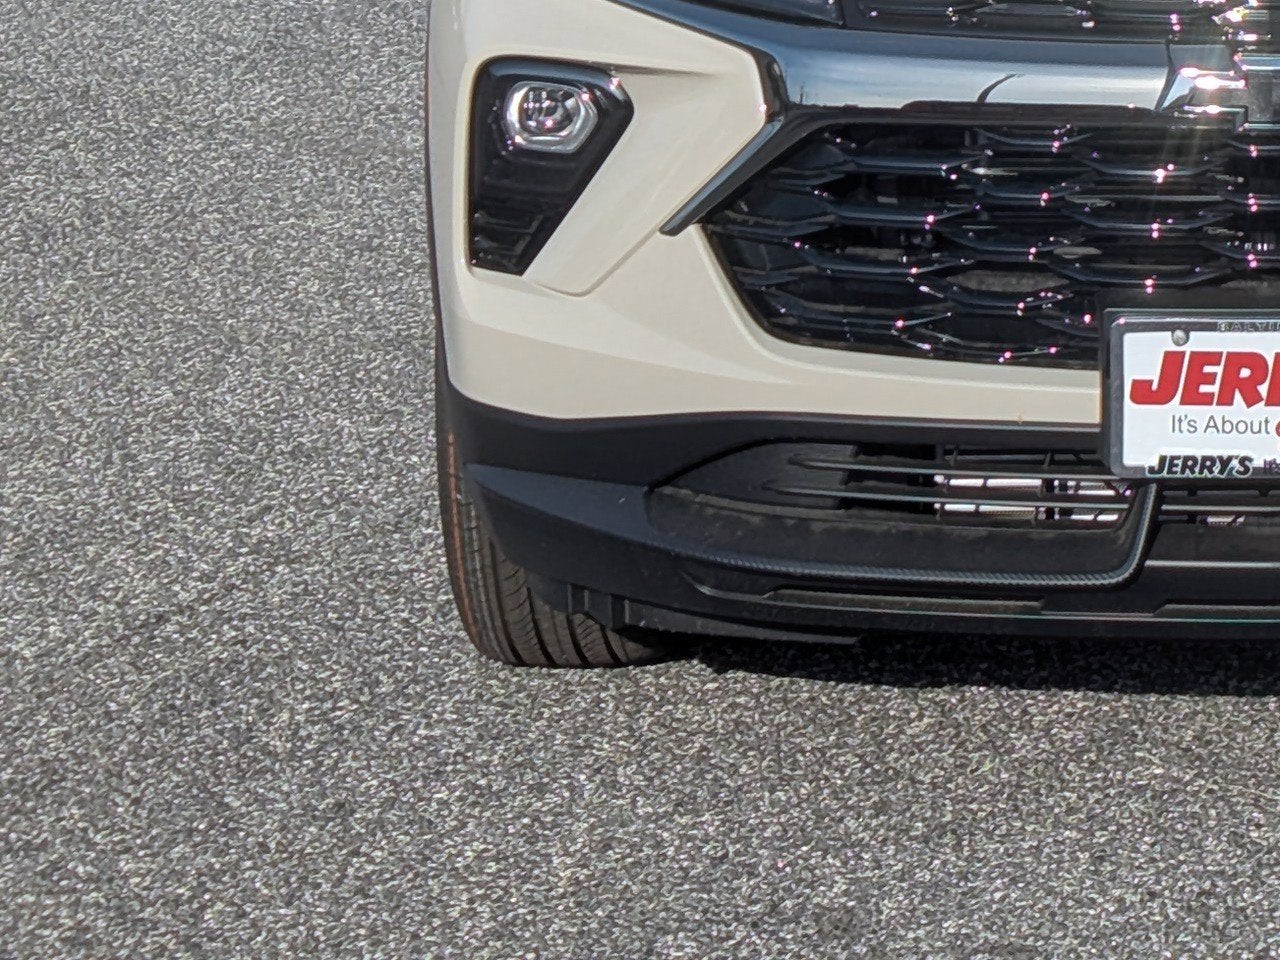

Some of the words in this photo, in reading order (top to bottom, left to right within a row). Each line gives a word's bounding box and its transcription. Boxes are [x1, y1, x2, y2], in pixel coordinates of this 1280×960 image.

[1171, 415, 1198, 435] It's
[1204, 414, 1271, 435] About
[1146, 453, 1254, 477] JERRY'S
